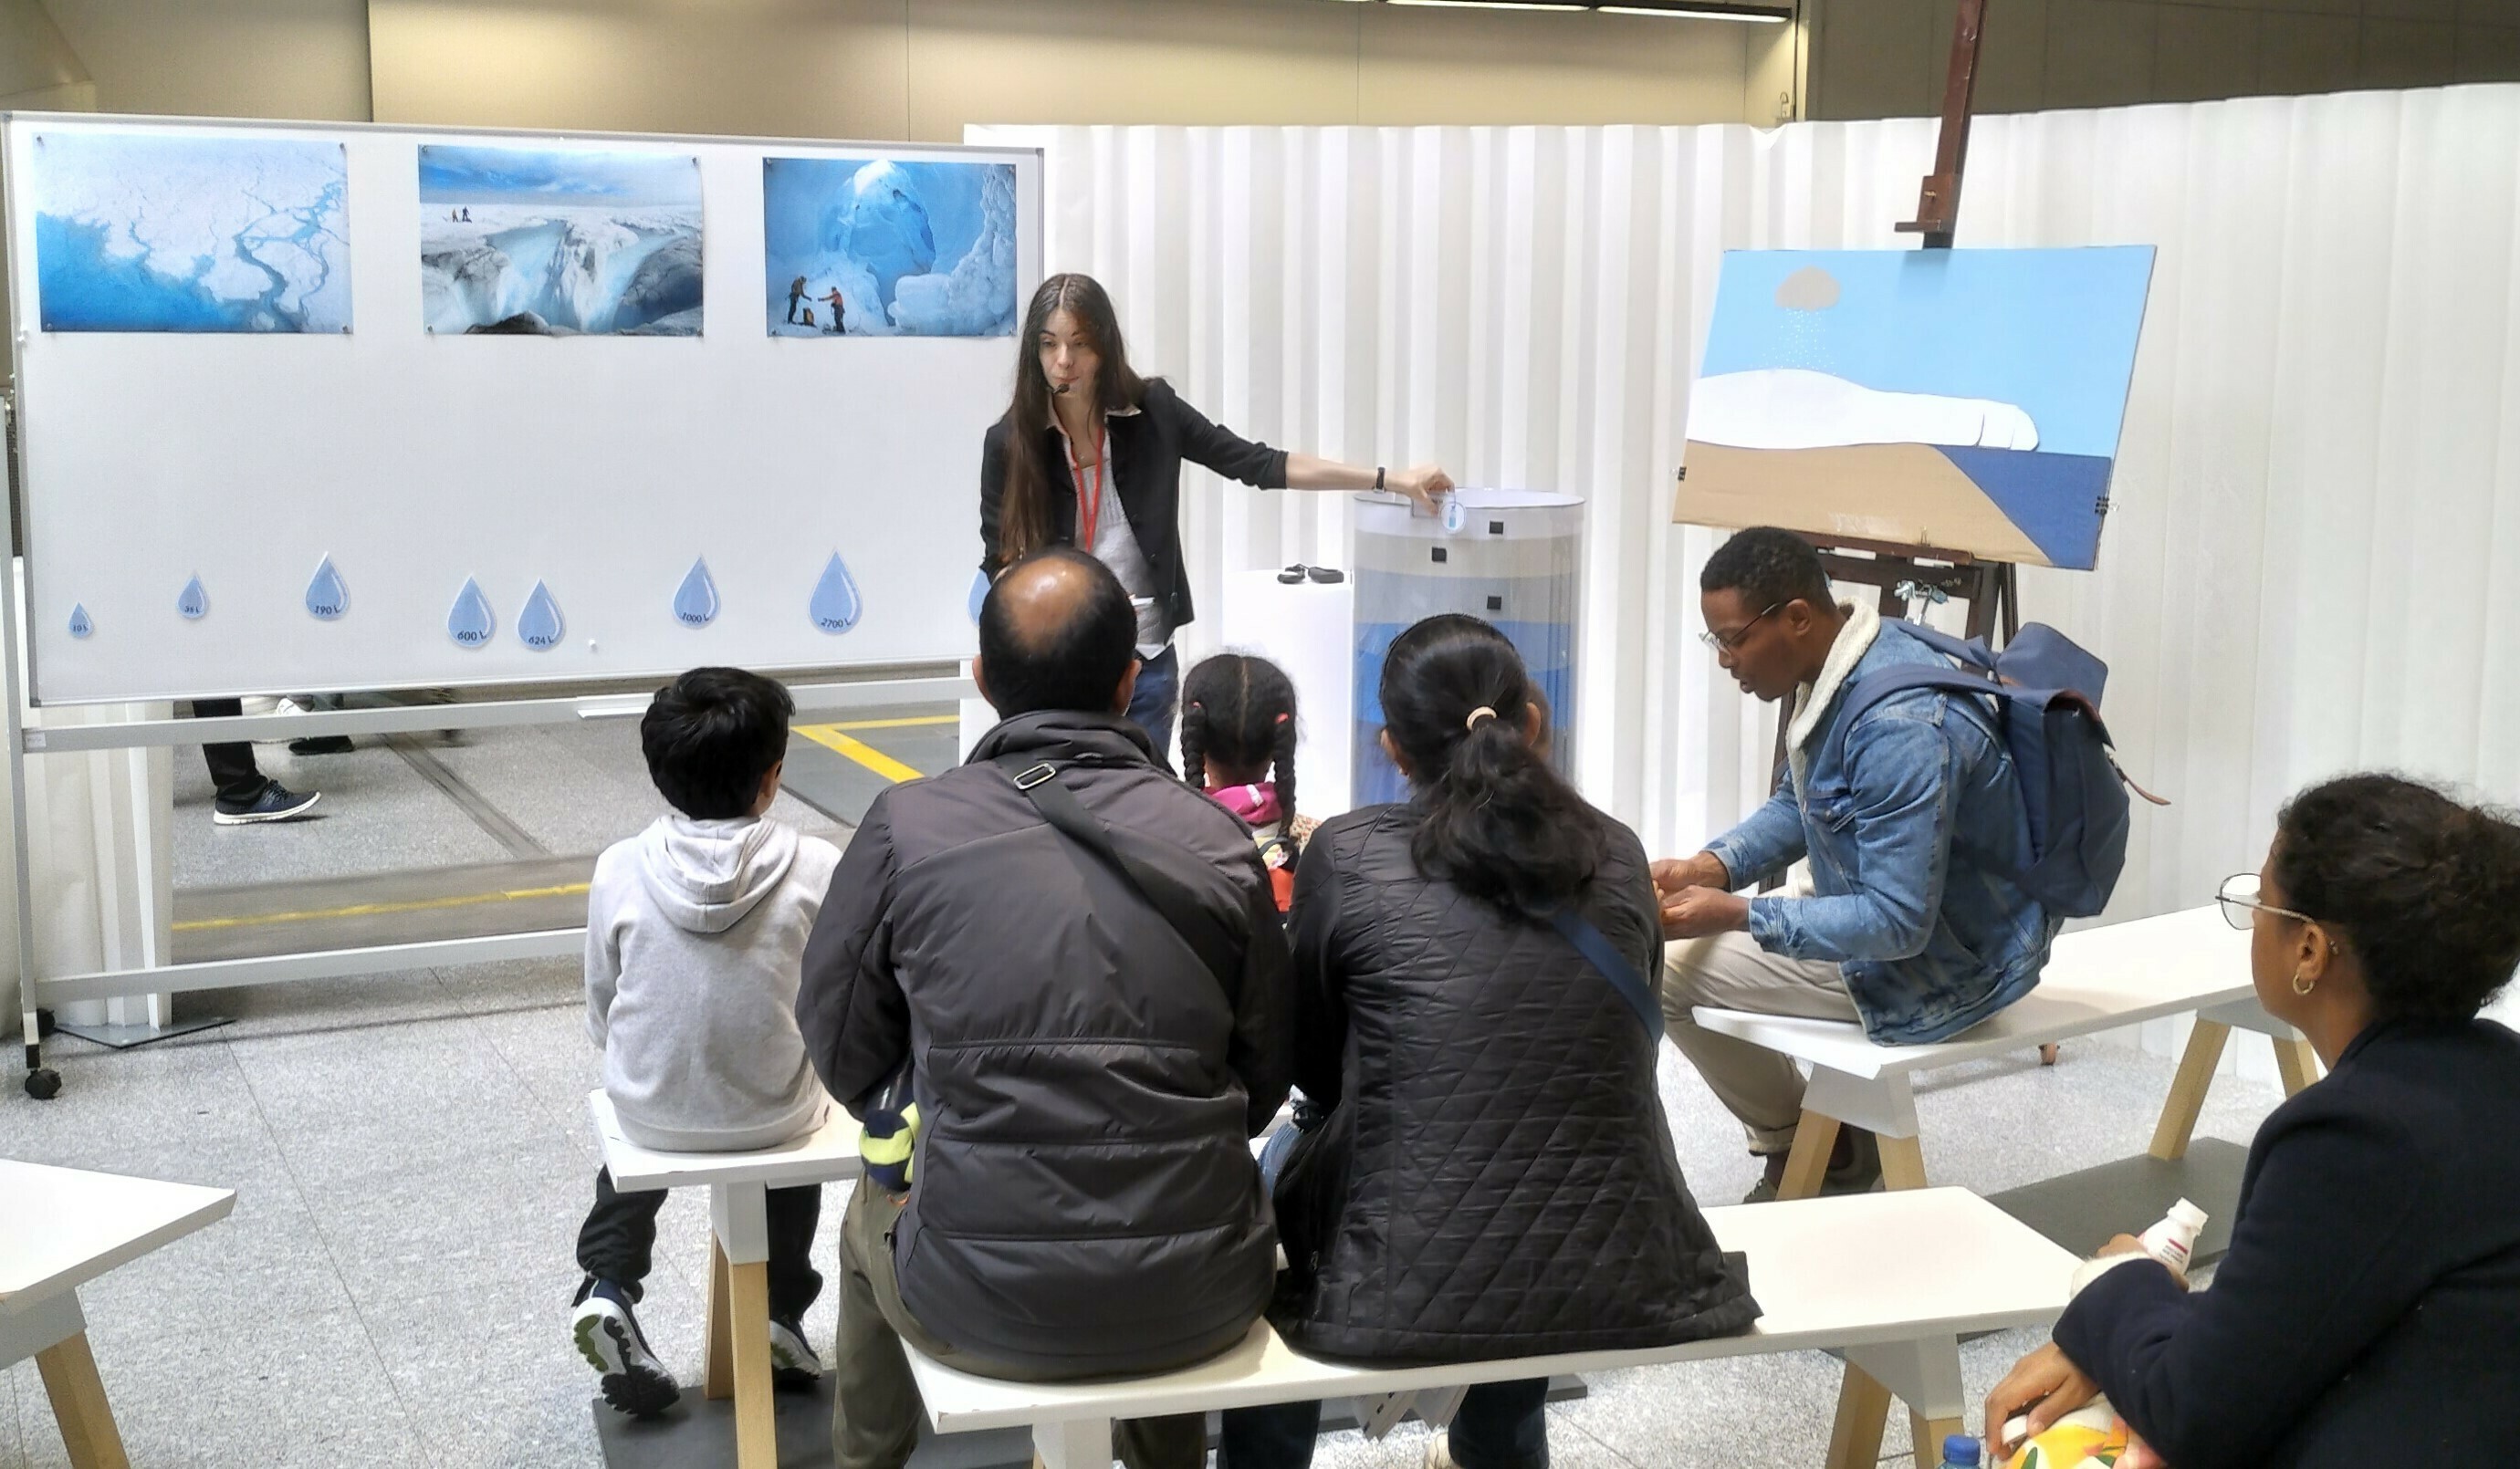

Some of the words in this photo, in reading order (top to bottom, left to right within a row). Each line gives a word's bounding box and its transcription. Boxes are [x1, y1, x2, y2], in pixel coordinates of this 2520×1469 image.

[314, 605, 332, 615] 190
[682, 611, 703, 623] 1000
[821, 617, 843, 629] 2700
[457, 630, 477, 641] 600
